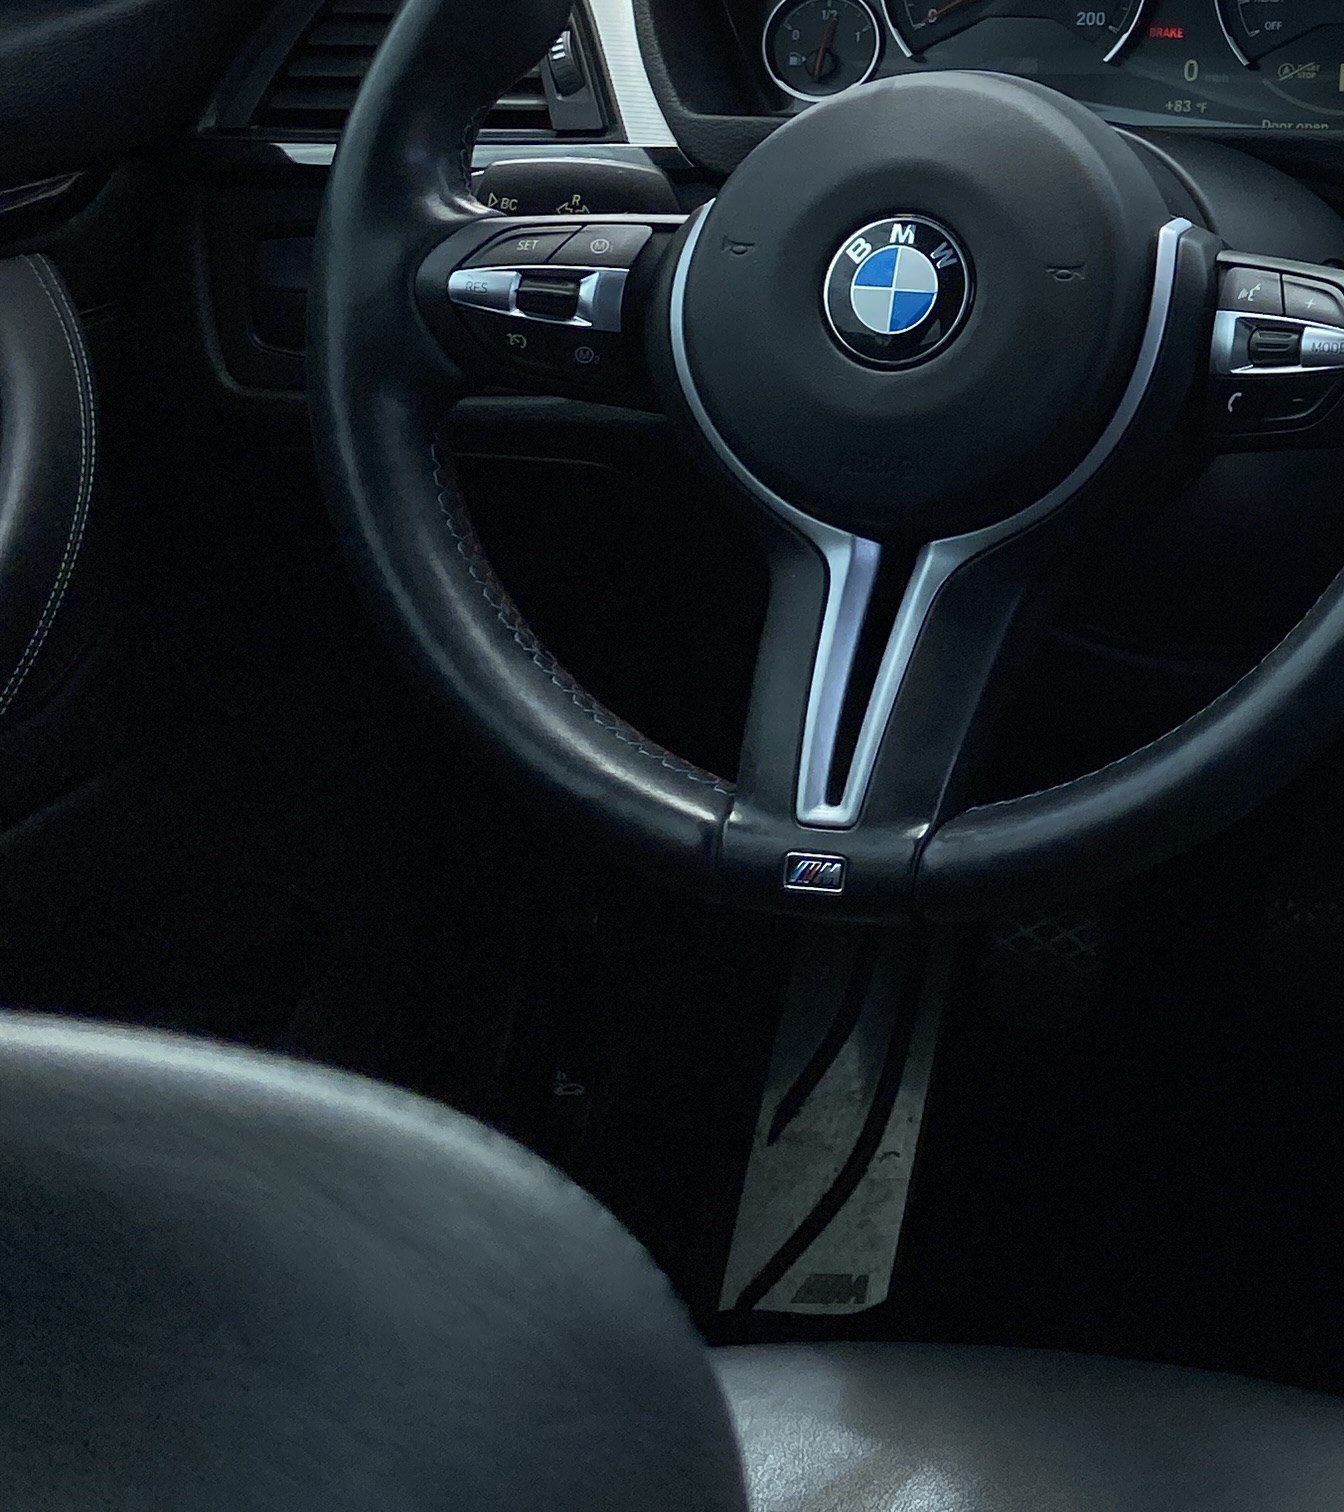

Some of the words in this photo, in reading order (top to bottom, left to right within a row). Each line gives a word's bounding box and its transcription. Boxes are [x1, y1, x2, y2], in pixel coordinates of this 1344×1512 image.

[1076, 12, 1106, 26] 200
[1264, 21, 1282, 31] OFF
[1150, 28, 1184, 38] BRAKE
[1184, 59, 1198, 82] 0
[1165, 99, 1191, 113] +83
[501, 197, 518, 211] BC
[571, 194, 581, 206] R
[517, 239, 539, 251] SET
[846, 223, 958, 269] BMW
[465, 281, 488, 294] RES
